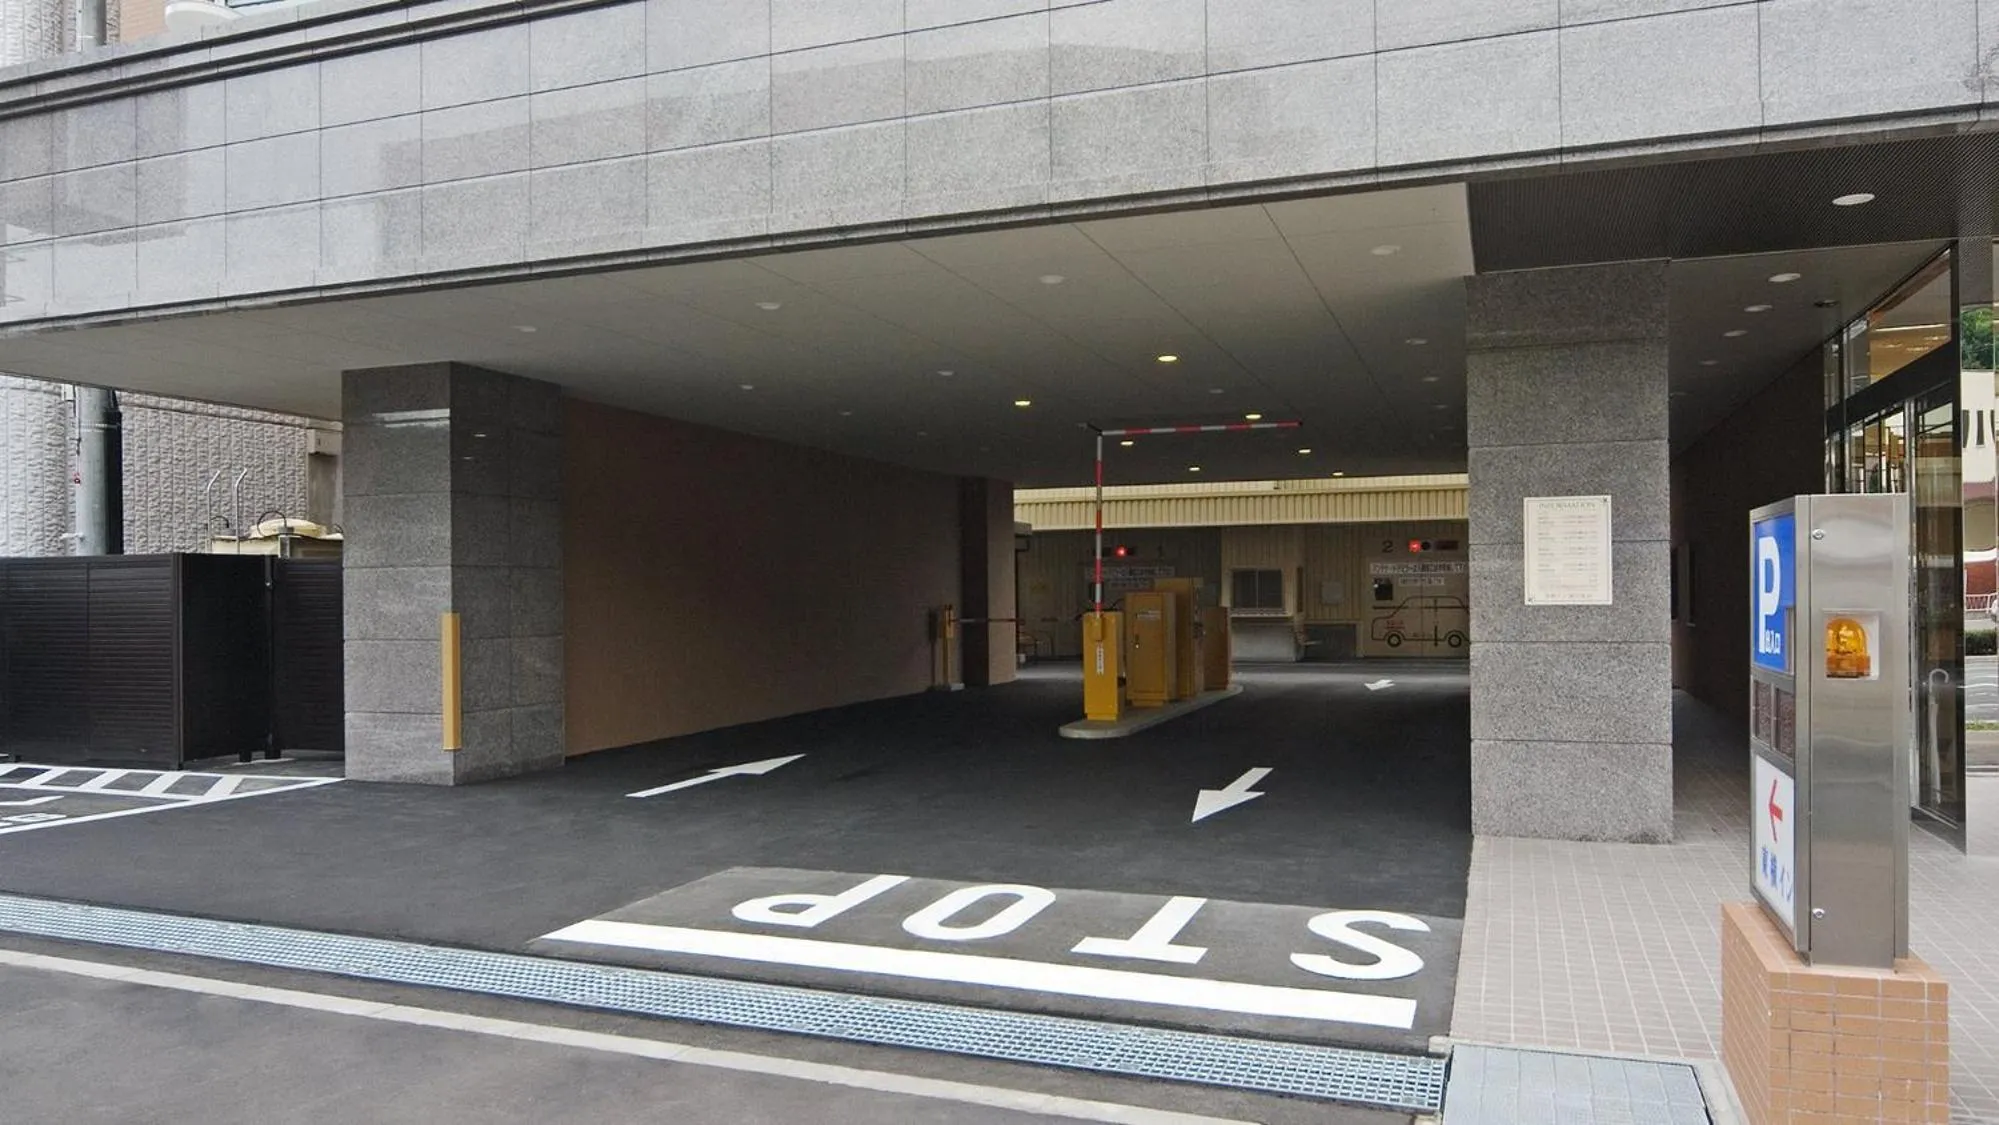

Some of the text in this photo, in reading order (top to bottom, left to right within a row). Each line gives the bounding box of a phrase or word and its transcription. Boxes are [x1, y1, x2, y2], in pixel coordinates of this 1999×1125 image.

[1382, 540, 1394, 553] 2
[1759, 536, 1780, 653] P
[732, 874, 1431, 980] STOP
